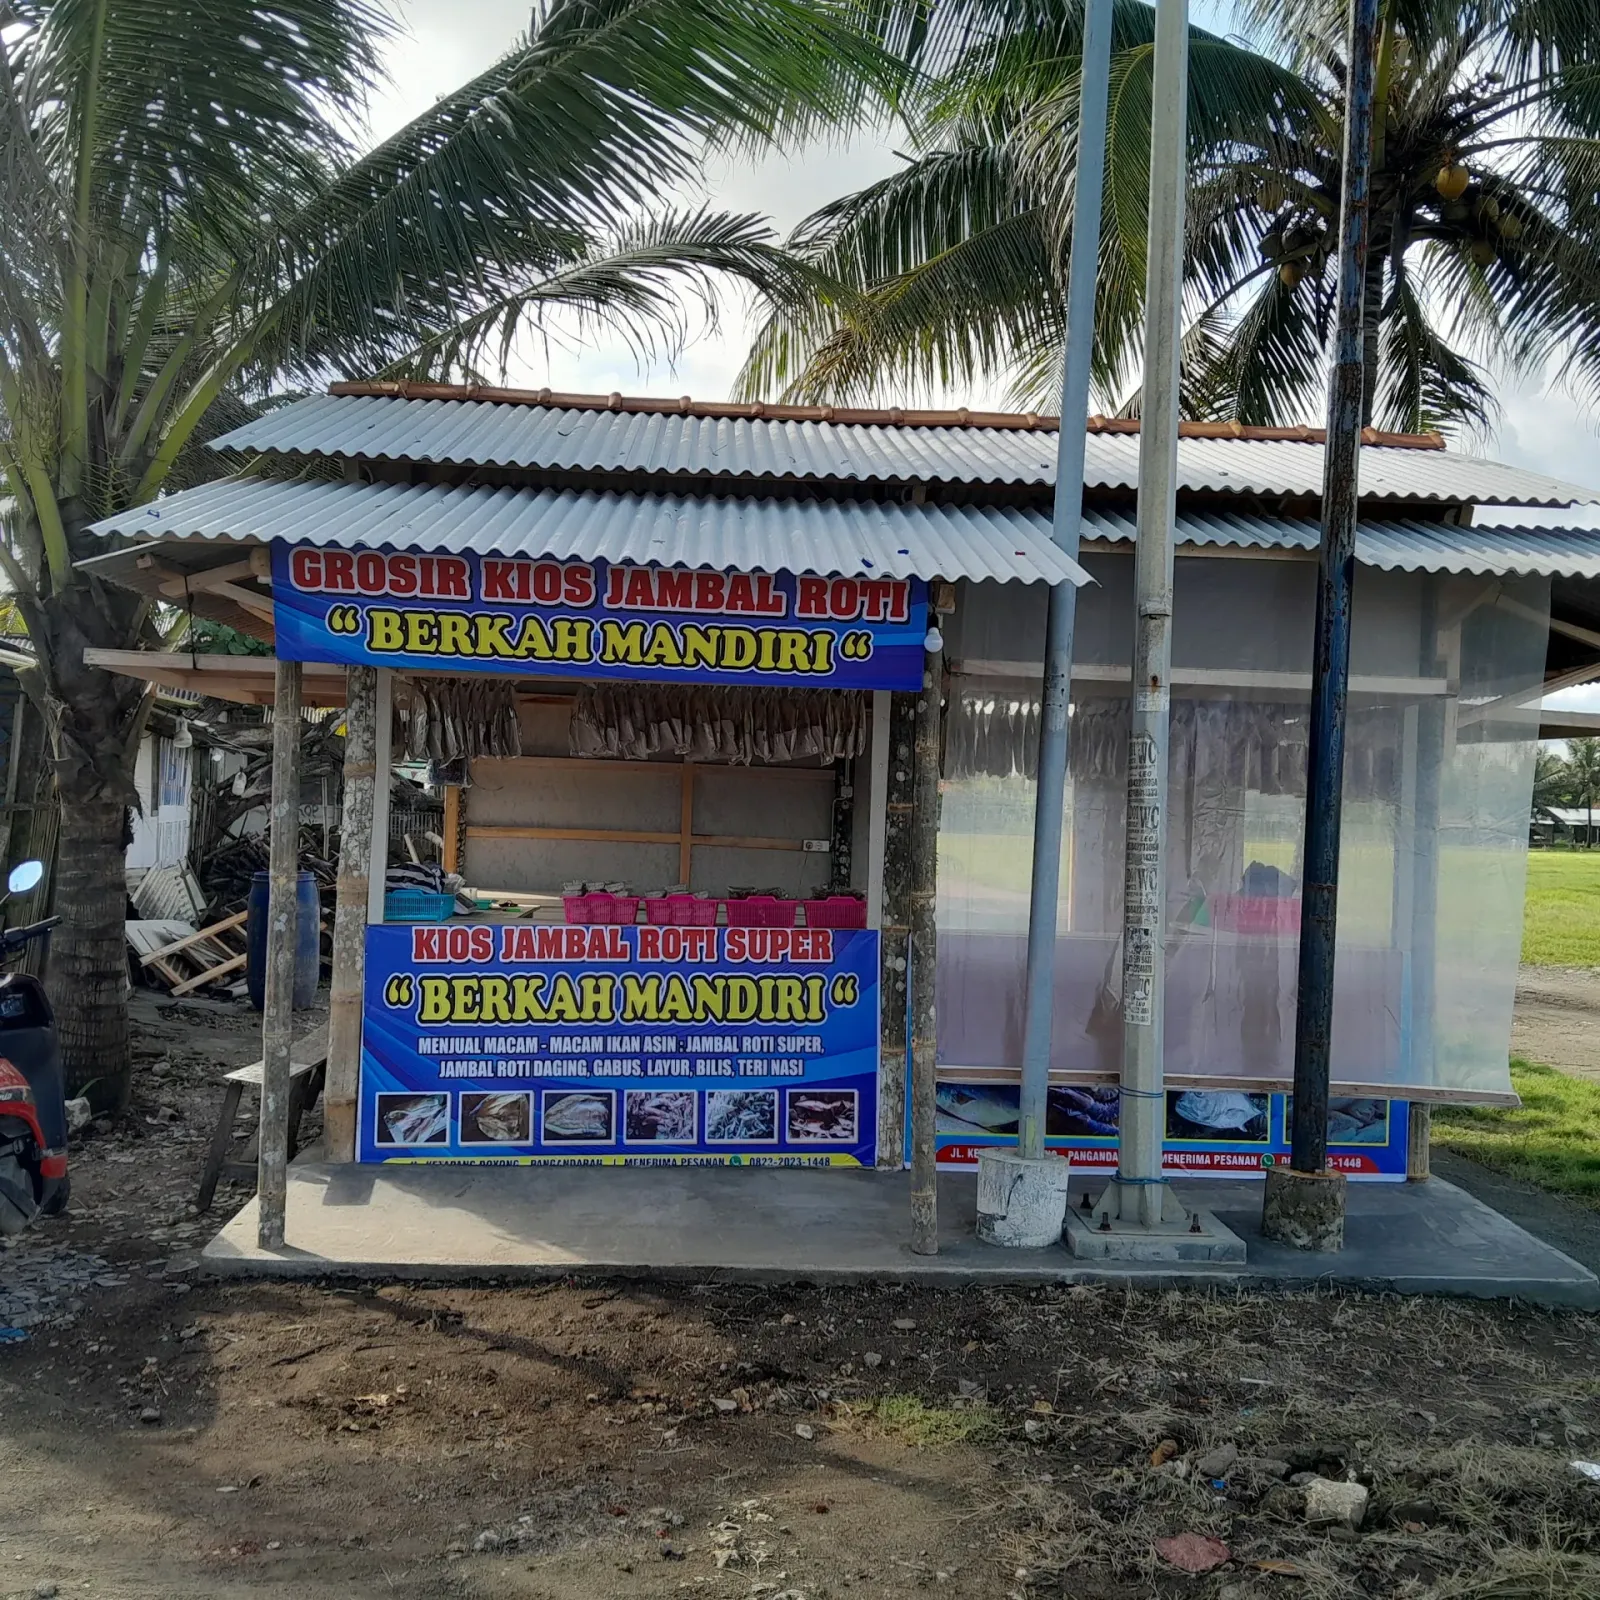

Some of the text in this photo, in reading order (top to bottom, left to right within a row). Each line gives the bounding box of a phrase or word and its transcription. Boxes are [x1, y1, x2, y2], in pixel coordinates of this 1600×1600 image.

[291, 548, 909, 620] GROSIR KIOS JAMBAL ROTI
[366, 607, 594, 662] BERKAH
[600, 620, 834, 674] MANDIRI
[412, 926, 834, 962] KIOS JAMBAL ROTI SUPER
[417, 975, 617, 1024] BERKAH
[621, 975, 825, 1024] MANDIRI
[418, 1037, 481, 1054] MENJUAL
[484, 1037, 538, 1054] MACAM
[550, 1036, 603, 1053] MACAM
[607, 1036, 641, 1053] IKAN
[643, 1036, 677, 1053] ASIN
[686, 1036, 739, 1053] JAMBAL
[742, 1036, 775, 1053] ROTI
[777, 1036, 825, 1055] SUPER,
[438, 1059, 803, 1078] JAMBAL ROTI DAGING, GABUS, LAYUR, BILIS, TERI NASI
[681, 1158, 724, 1166] PESANAN
[951, 1147, 964, 1158] JL.
[1068, 1150, 1119, 1162] PANGANDA
[1162, 1153, 1211, 1165] MENERIMA
[1214, 1155, 1257, 1166] PESANAN
